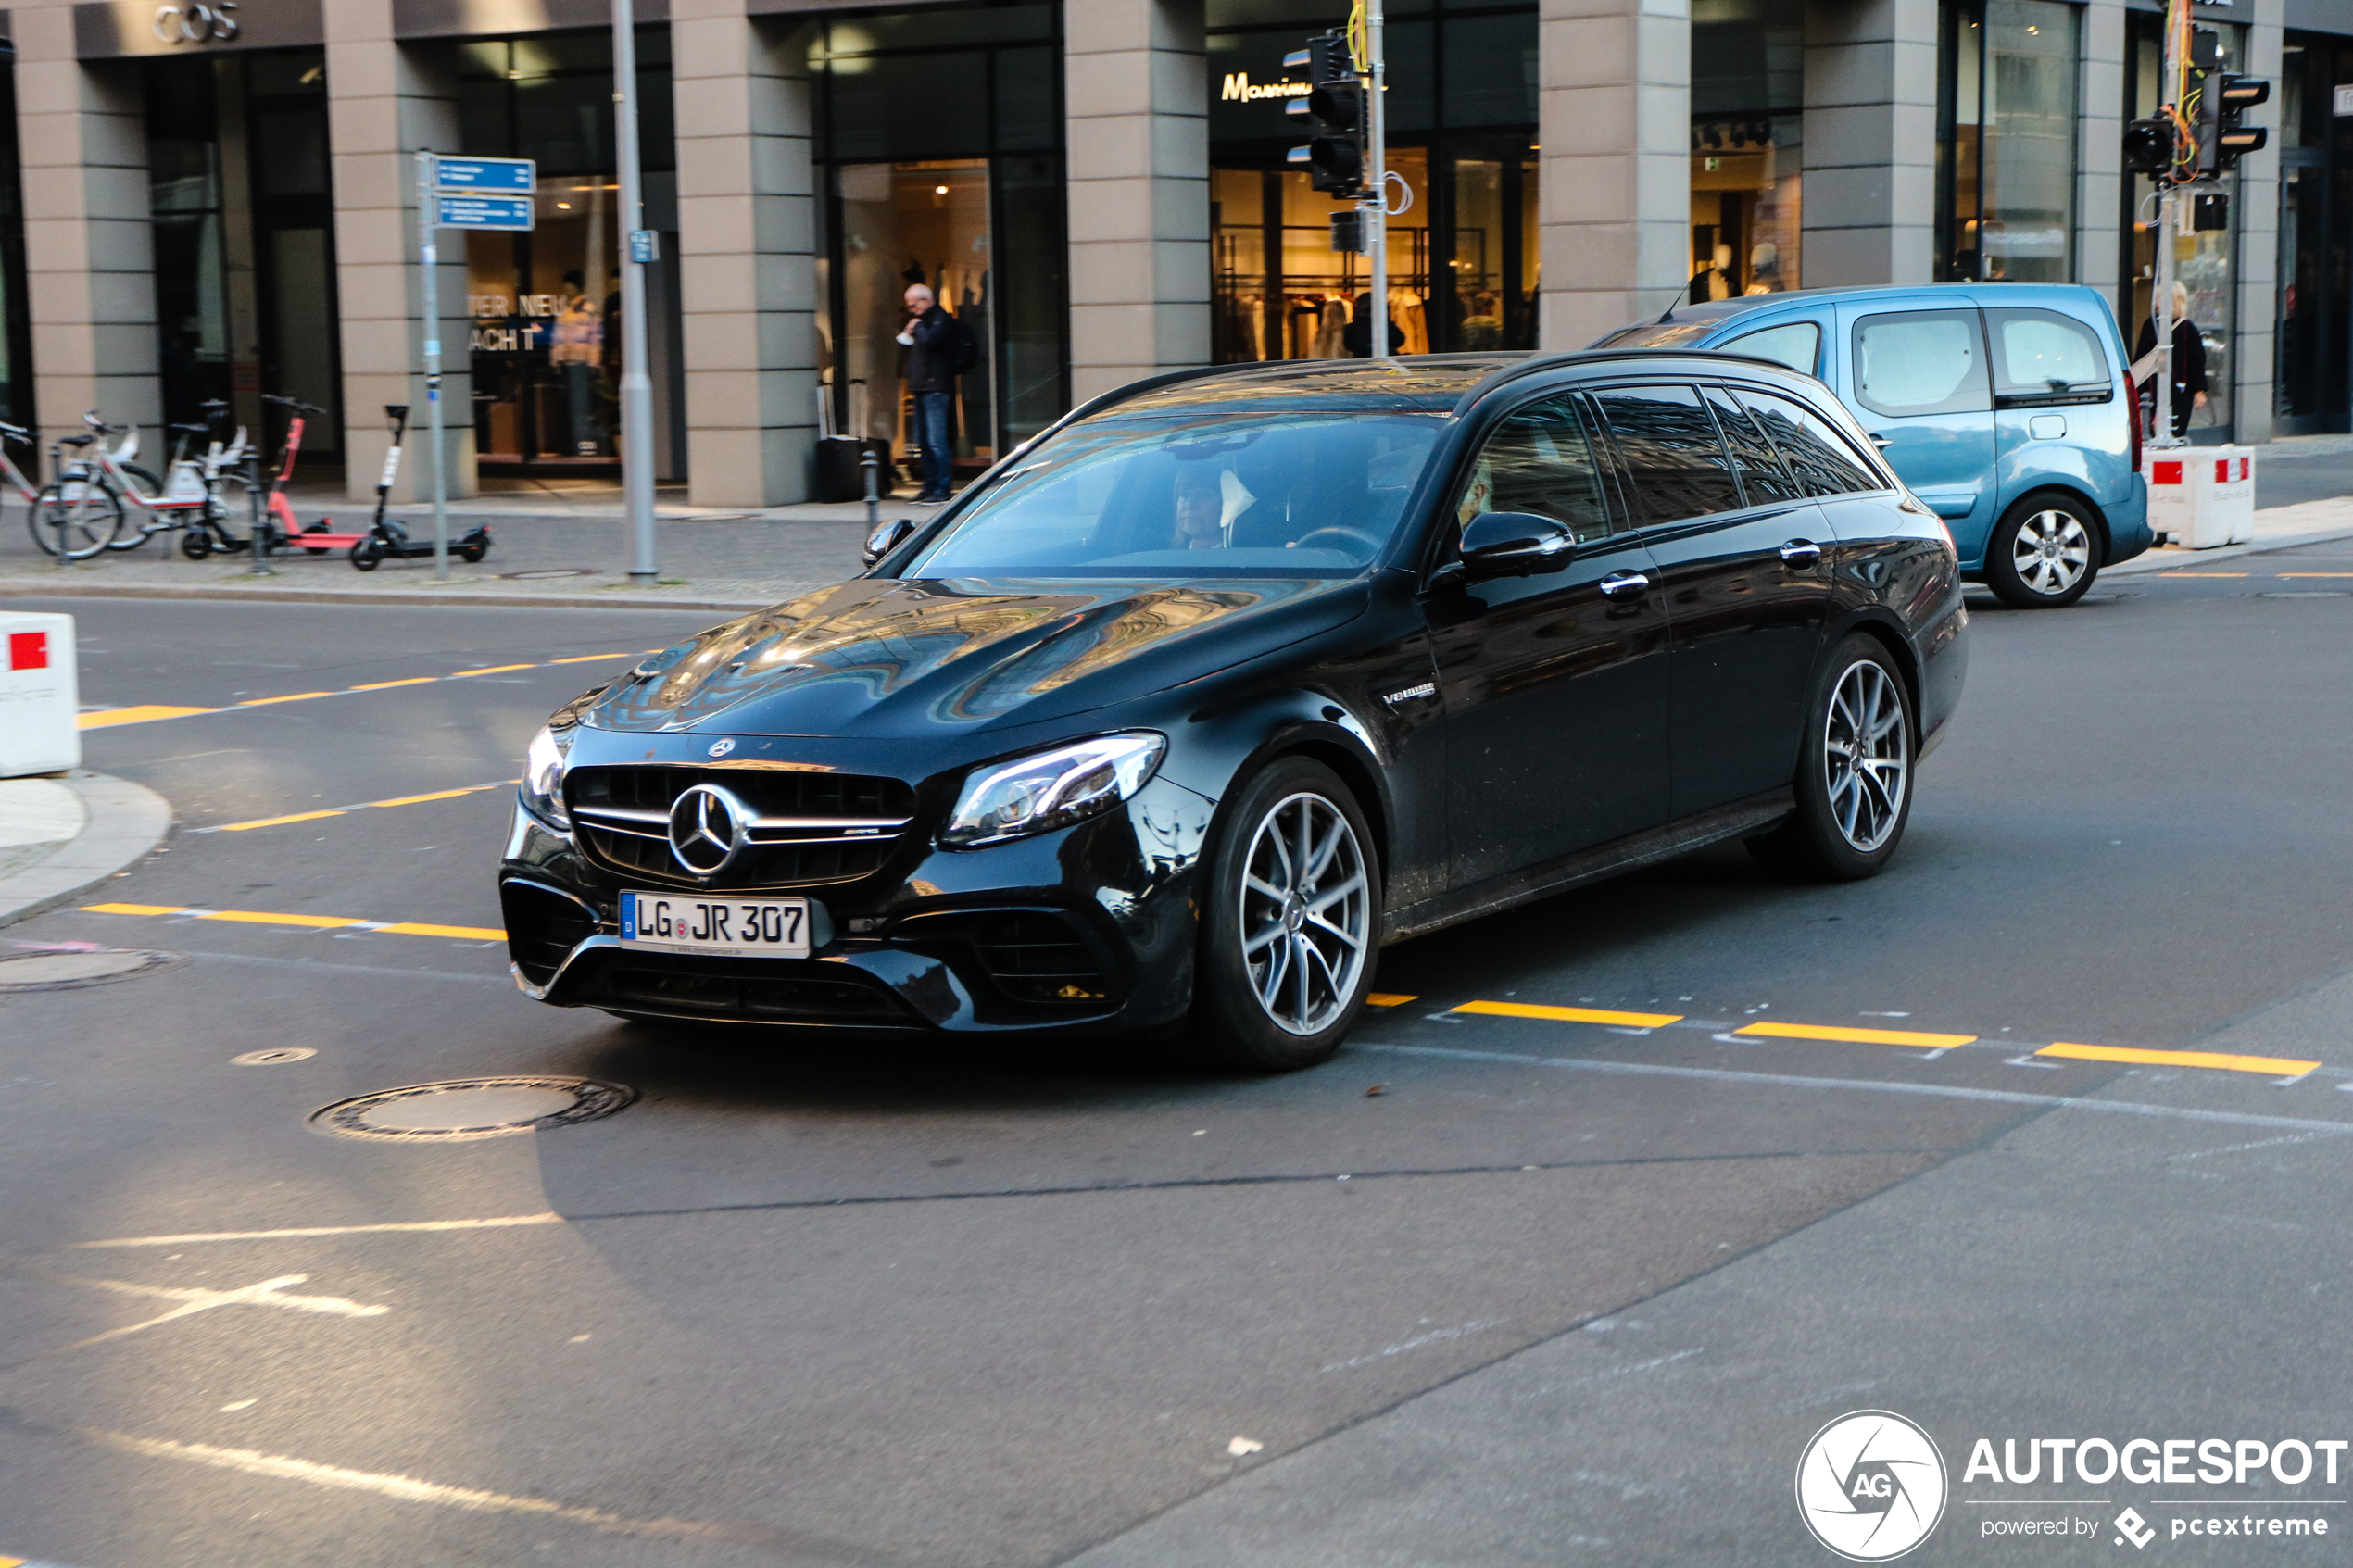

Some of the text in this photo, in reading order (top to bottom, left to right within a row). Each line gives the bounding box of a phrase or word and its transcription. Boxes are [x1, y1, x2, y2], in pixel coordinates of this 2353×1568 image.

[154, 2, 239, 44] COS
[1383, 691, 1403, 705] V8
[638, 899, 804, 944] LG JR 307
